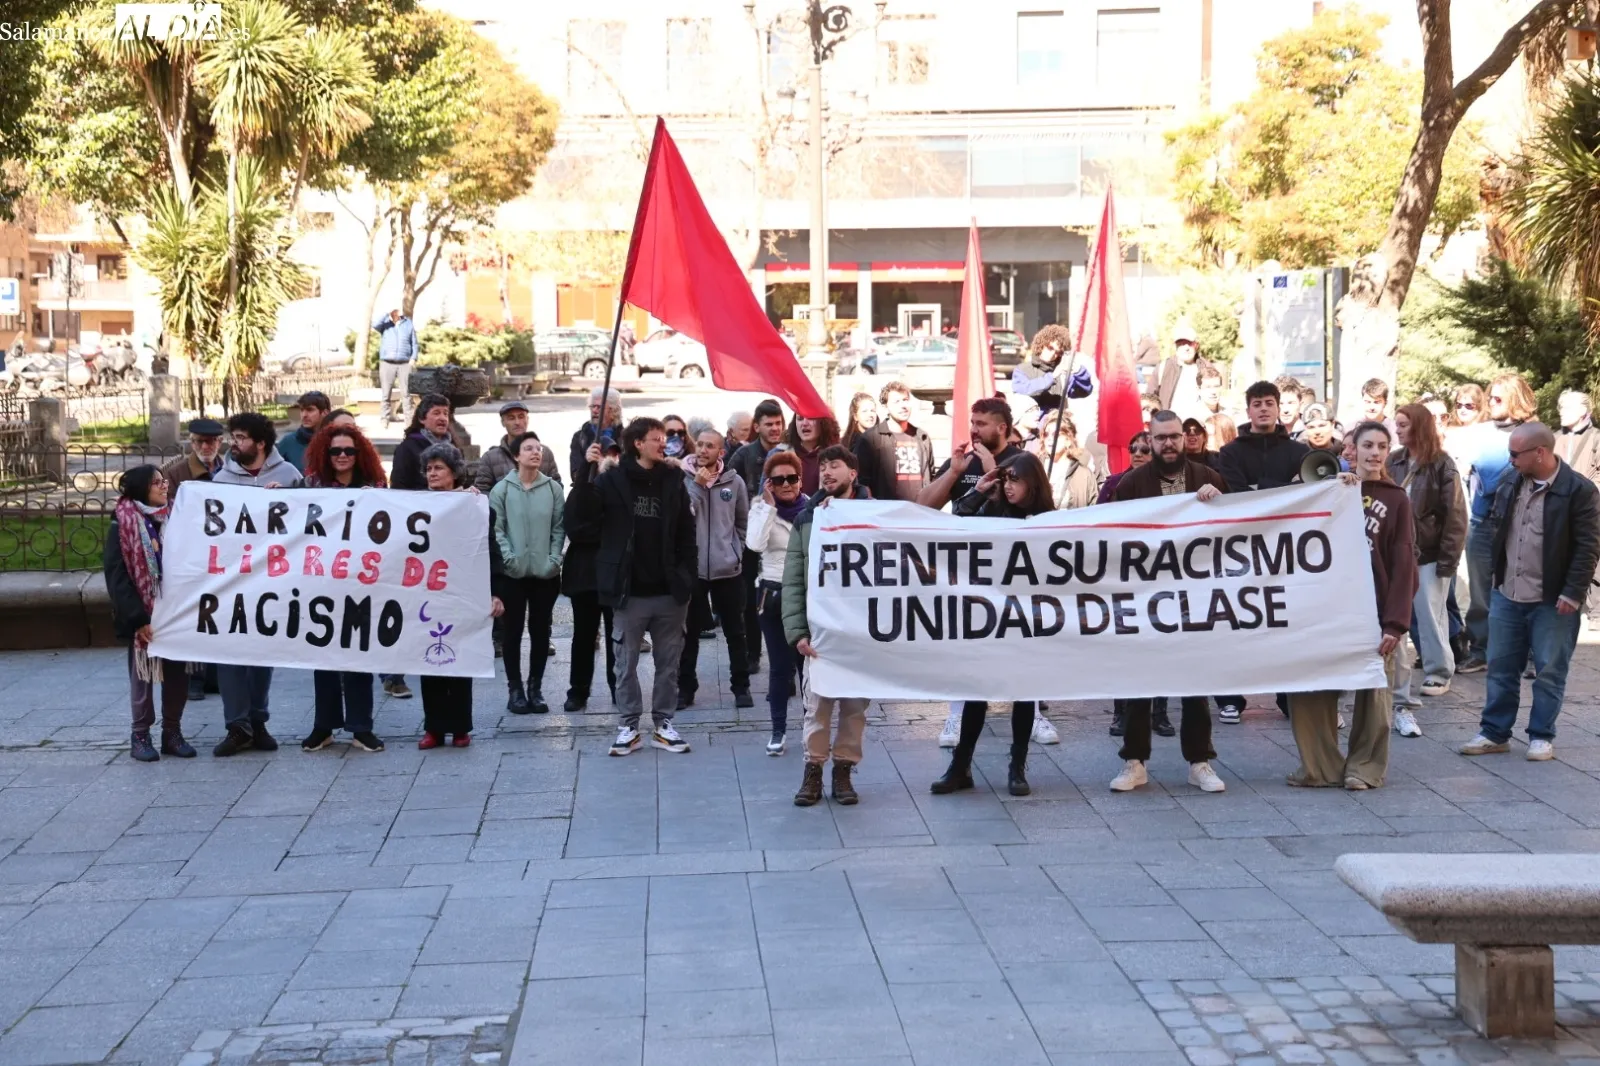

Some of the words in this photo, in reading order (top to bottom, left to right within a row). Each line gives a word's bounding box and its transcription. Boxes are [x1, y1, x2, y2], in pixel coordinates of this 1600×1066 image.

[401, 555, 449, 591] DE
[818, 540, 994, 588] FRENTE
[1001, 540, 1040, 586] A
[1046, 539, 1108, 586] SU
[1119, 529, 1333, 583] RACISMO
[867, 592, 1066, 643] UNIDAD
[1075, 592, 1140, 636] DE
[1147, 585, 1289, 634] CLASE
